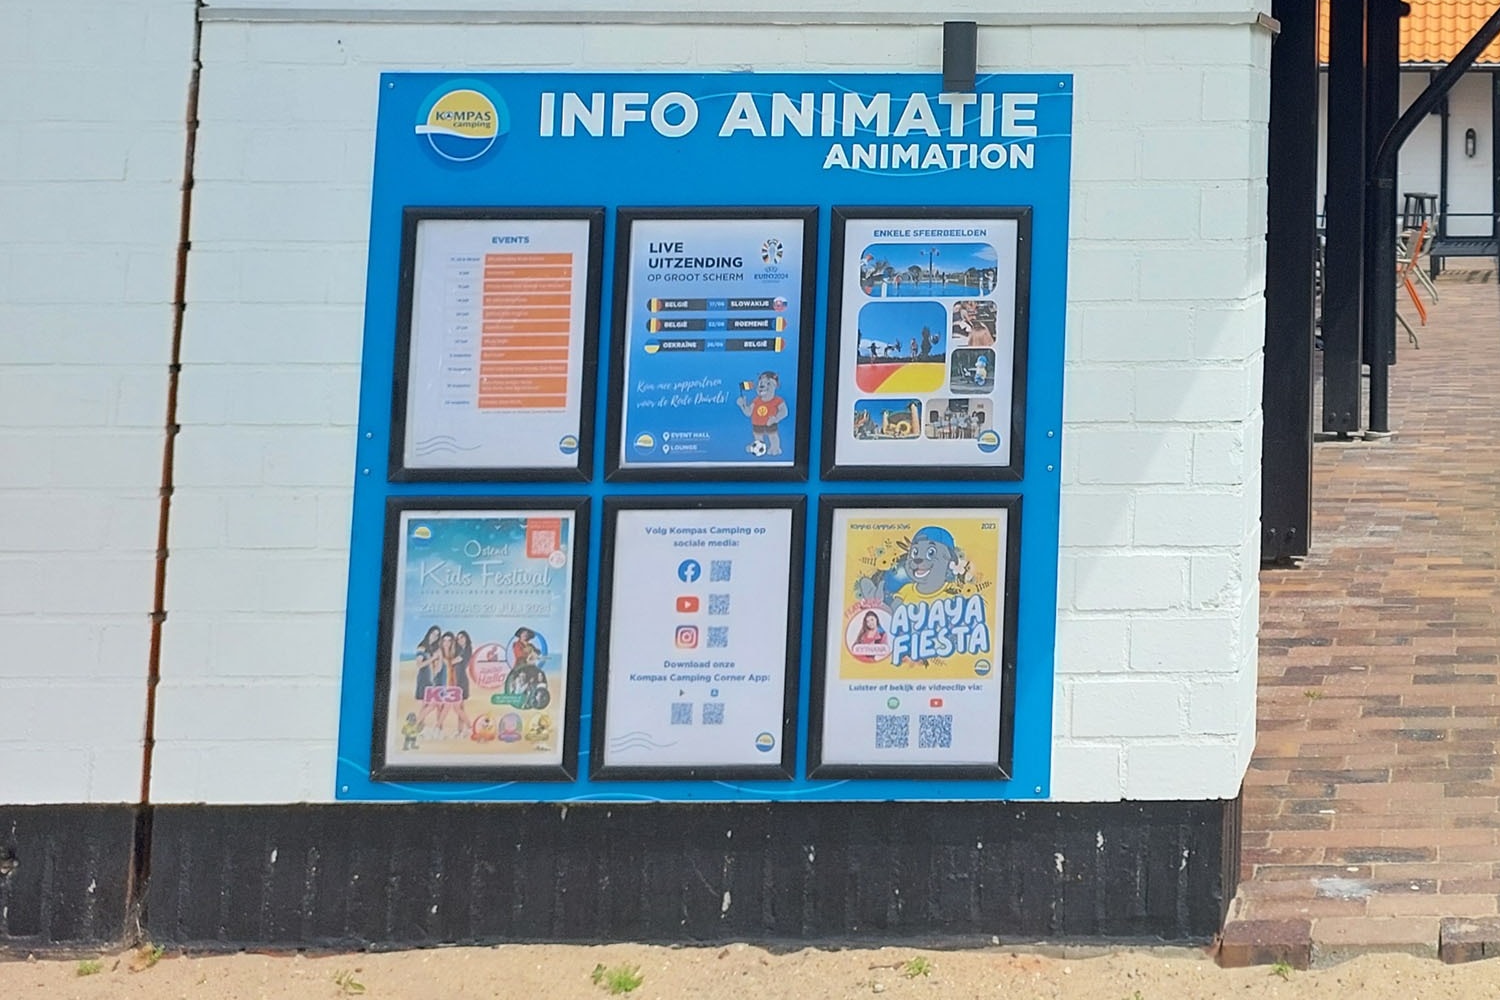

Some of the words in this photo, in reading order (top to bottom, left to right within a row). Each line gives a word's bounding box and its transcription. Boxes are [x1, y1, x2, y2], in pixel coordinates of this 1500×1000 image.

[436, 111, 491, 121] KOMPAS
[540, 91, 699, 138] INFO
[718, 92, 1039, 138] ANIMATIE
[453, 121, 491, 129] camping
[823, 143, 1035, 169] ANIMATION
[873, 229, 911, 238] ENKELE
[913, 229, 987, 238] SFEERBEELDEN
[491, 236, 530, 244] EVENTS
[649, 242, 684, 254] LIVE
[648, 257, 743, 269] UITZENDING
[647, 273, 662, 282] OP
[664, 273, 700, 282] GROOT
[702, 273, 744, 282] SCHERM
[730, 300, 770, 308] SLOWAKIJE
[734, 320, 769, 328] ROEMENIË
[673, 376, 722, 392] supporteren
[657, 396, 668, 407] de
[645, 526, 667, 536] Volg
[669, 527, 707, 535] Kompas
[710, 526, 751, 535] Camping
[673, 539, 706, 547] sociale
[708, 539, 740, 547] media:
[420, 560, 472, 587] Kids
[472, 560, 552, 587] Festival
[891, 595, 985, 636] AYAYA
[892, 623, 990, 667] FIESTA
[664, 660, 711, 669] Download
[629, 673, 668, 682] Kompas
[669, 673, 712, 683] Camping
[713, 673, 745, 682] Corner
[748, 673, 770, 683] App:
[889, 684, 914, 692] bekijk
[928, 684, 966, 692] videoclip
[425, 686, 463, 703] K3
